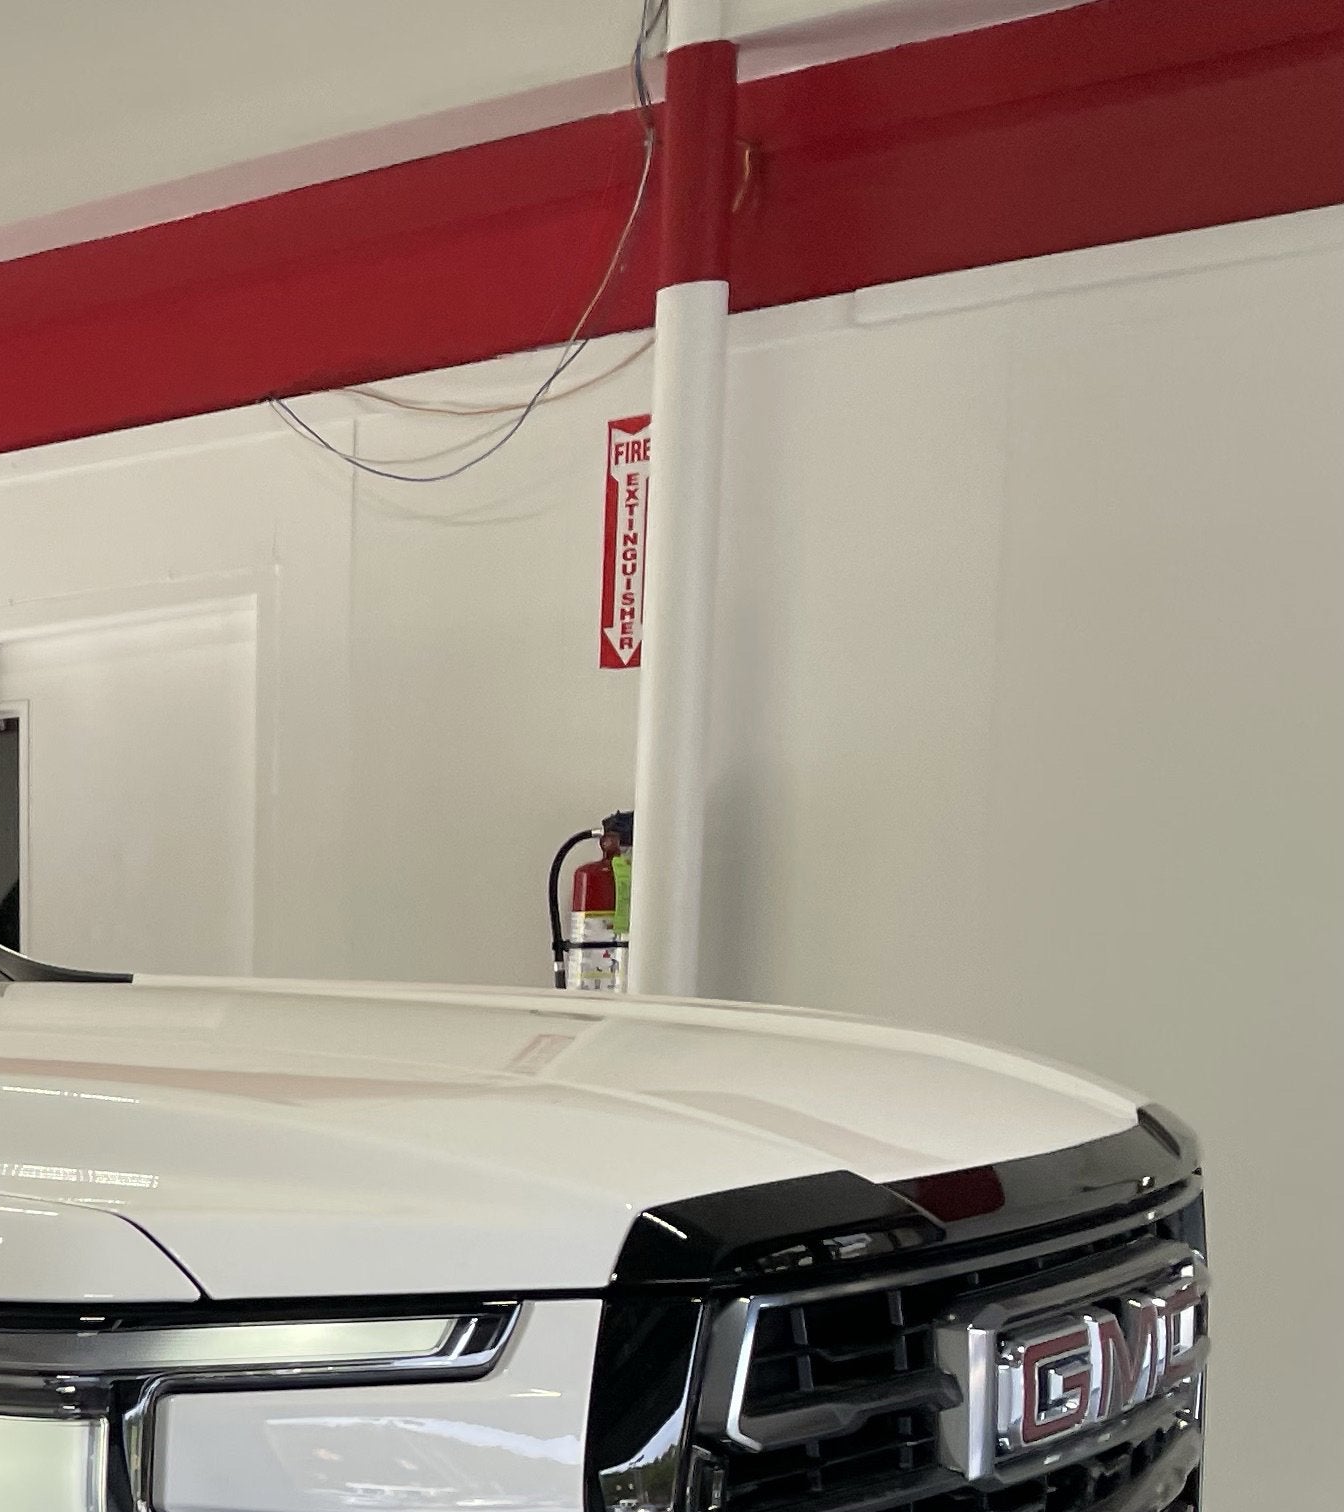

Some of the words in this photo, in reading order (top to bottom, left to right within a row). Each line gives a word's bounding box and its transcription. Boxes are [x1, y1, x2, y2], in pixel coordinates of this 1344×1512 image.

[614, 437, 651, 466] FIRE
[619, 473, 640, 650] EXTINGUISHER
[1010, 1284, 1204, 1447] GMC
